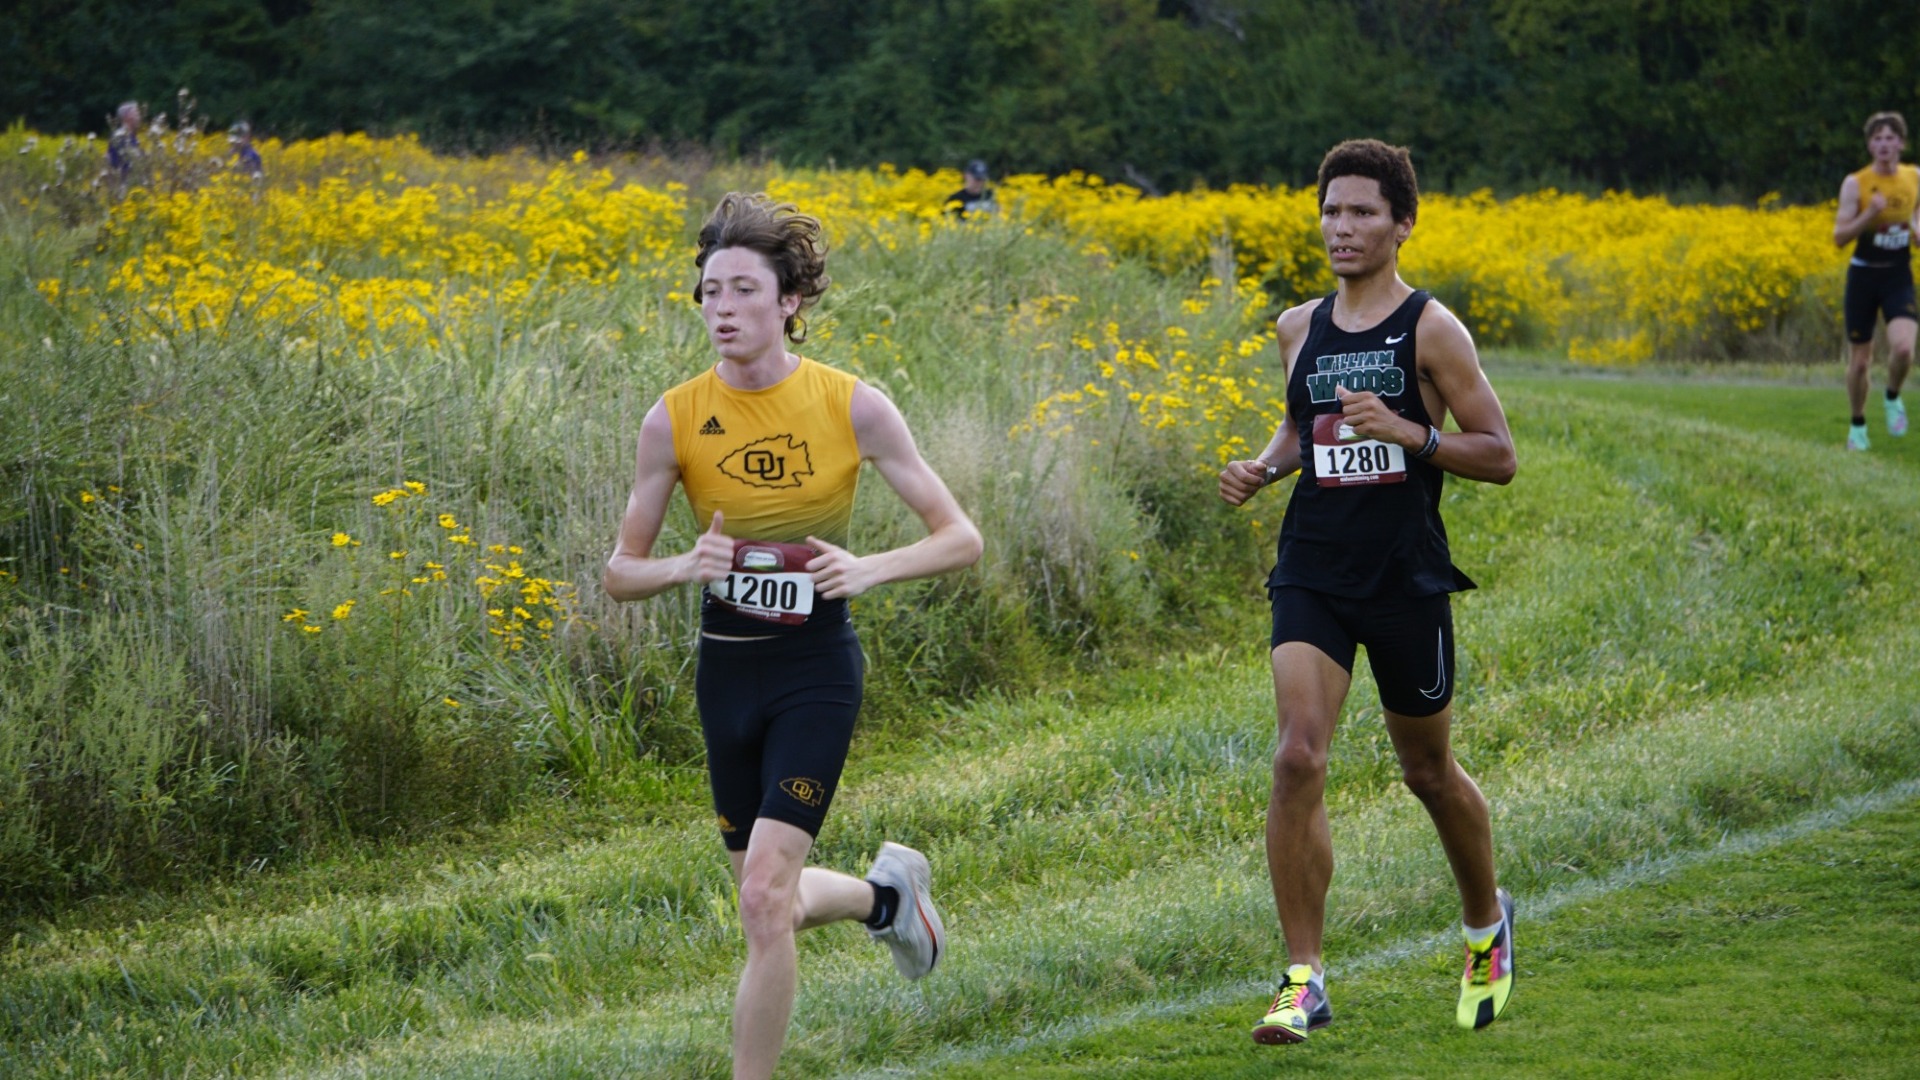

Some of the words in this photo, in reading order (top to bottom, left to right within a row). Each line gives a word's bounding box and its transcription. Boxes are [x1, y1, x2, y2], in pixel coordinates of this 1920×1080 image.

[1316, 350, 1394, 372] WILLIAM
[744, 450, 785, 480] OU
[1327, 444, 1390, 475] 1280
[724, 574, 798, 611] 1200
[792, 780, 814, 800] OU
